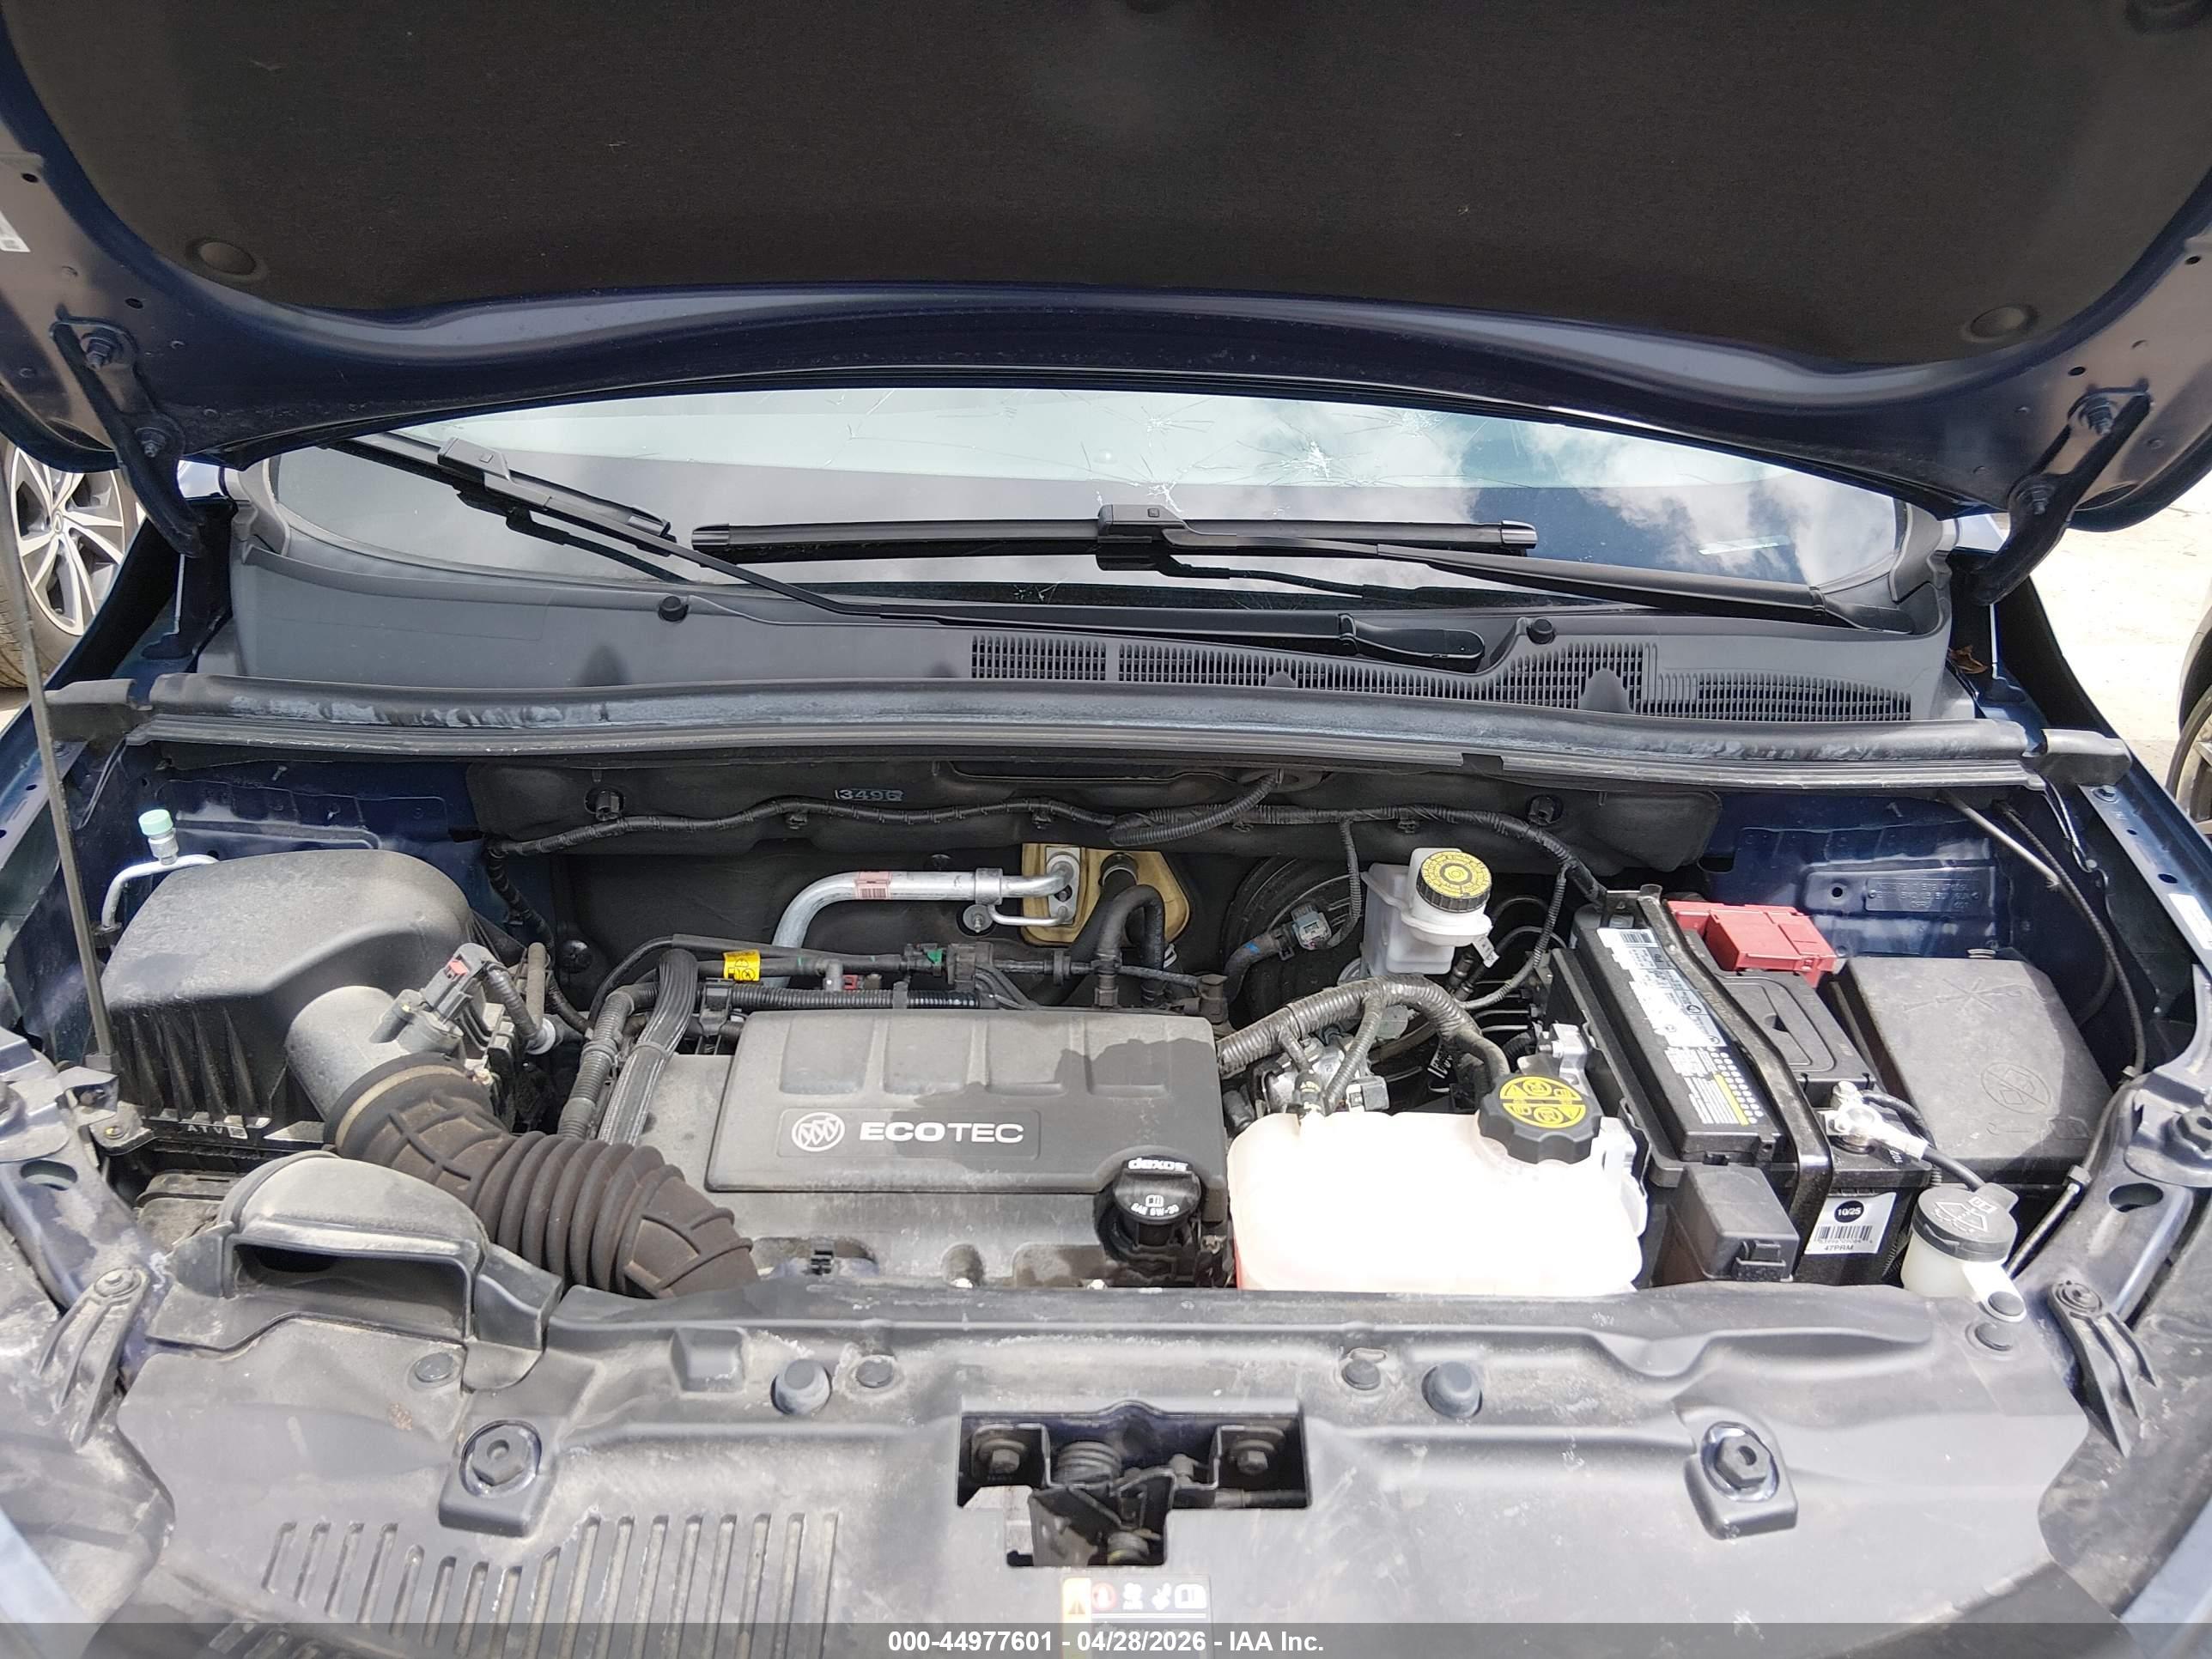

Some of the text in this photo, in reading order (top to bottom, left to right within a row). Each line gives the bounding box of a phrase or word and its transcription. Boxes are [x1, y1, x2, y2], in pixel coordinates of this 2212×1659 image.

[859, 1121, 1024, 1143] ECOTEC
[1128, 1158, 1188, 1171] dexos
[1837, 1206, 1862, 1217] 10/25
